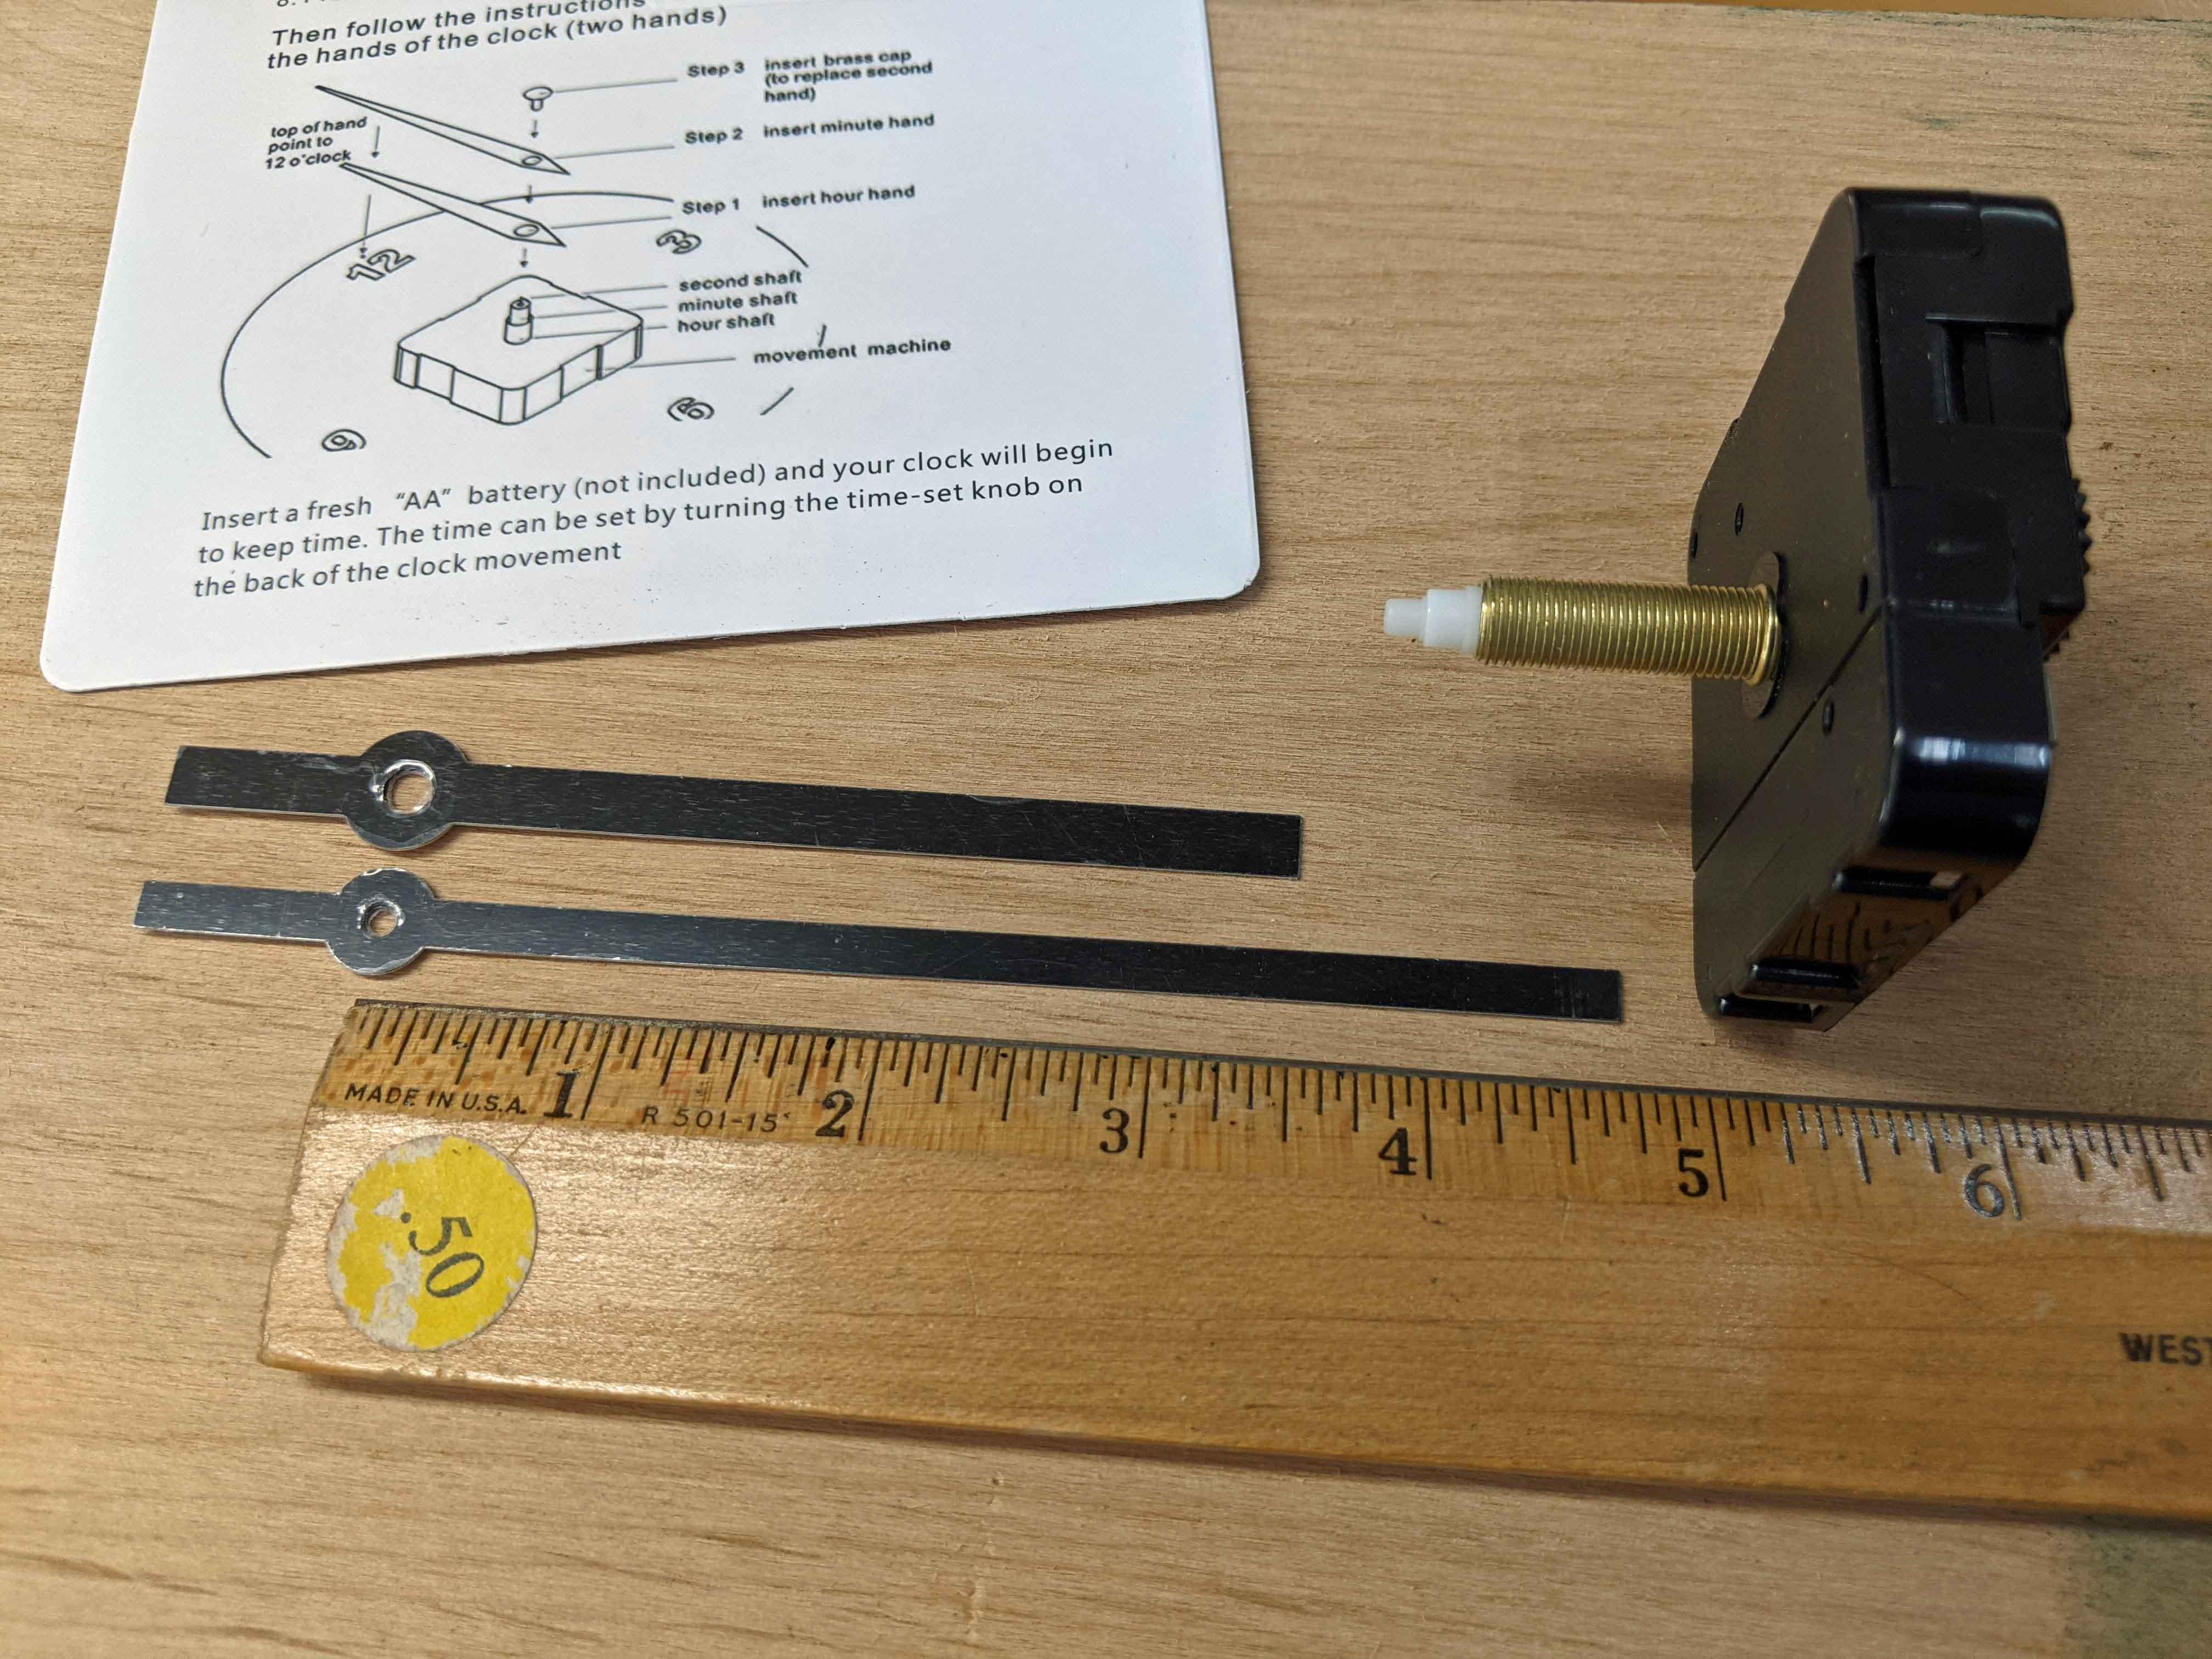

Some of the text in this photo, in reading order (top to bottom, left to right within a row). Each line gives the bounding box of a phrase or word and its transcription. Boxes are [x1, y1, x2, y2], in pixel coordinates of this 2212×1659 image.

[267, 5, 727, 70] the hands of the clock (two hands)
[272, 27, 337, 46] Then
[346, 17, 427, 38] follow
[434, 10, 476, 29] the
[686, 50, 912, 78] Step 3 insert brass cap
[764, 61, 934, 88] (to replace second
[763, 86, 816, 103] hand)
[270, 115, 368, 139] top of hand
[684, 113, 935, 145] Step 2 insert minute hand
[267, 136, 334, 156] point to
[264, 156, 287, 170] 12
[681, 184, 916, 216] Step 1 insert hour hand
[655, 228, 703, 255] 3
[346, 249, 417, 281] 12
[679, 269, 803, 292] second shaft
[678, 290, 798, 313] minute shaft
[677, 312, 775, 333] hour shaft
[753, 338, 952, 364] movement machine
[201, 506, 279, 531] Insert
[285, 508, 298, 523] a
[307, 495, 372, 521] fresh
[468, 483, 567, 505] battery
[574, 475, 630, 500] (not
[637, 463, 766, 492] included)
[775, 458, 824, 481] and
[832, 459, 895, 483] your
[903, 448, 974, 472] clock
[980, 443, 1026, 466] will
[1036, 438, 1113, 465] begin
[198, 476, 1082, 564] to keep time. The time can be set by turning the time-set knob on
[194, 542, 622, 597] the back of the clock movement
[345, 1082, 527, 1115] MADE IN U.S.A.
[544, 1068, 580, 1118] 1
[641, 1105, 659, 1125] R
[815, 1089, 855, 1137] 2
[1099, 1107, 1130, 1154] 3
[1378, 1127, 1418, 1176] 4
[1677, 1148, 1709, 1198] 5
[1962, 1163, 2006, 1218] 6
[400, 1211, 485, 1298] .50
